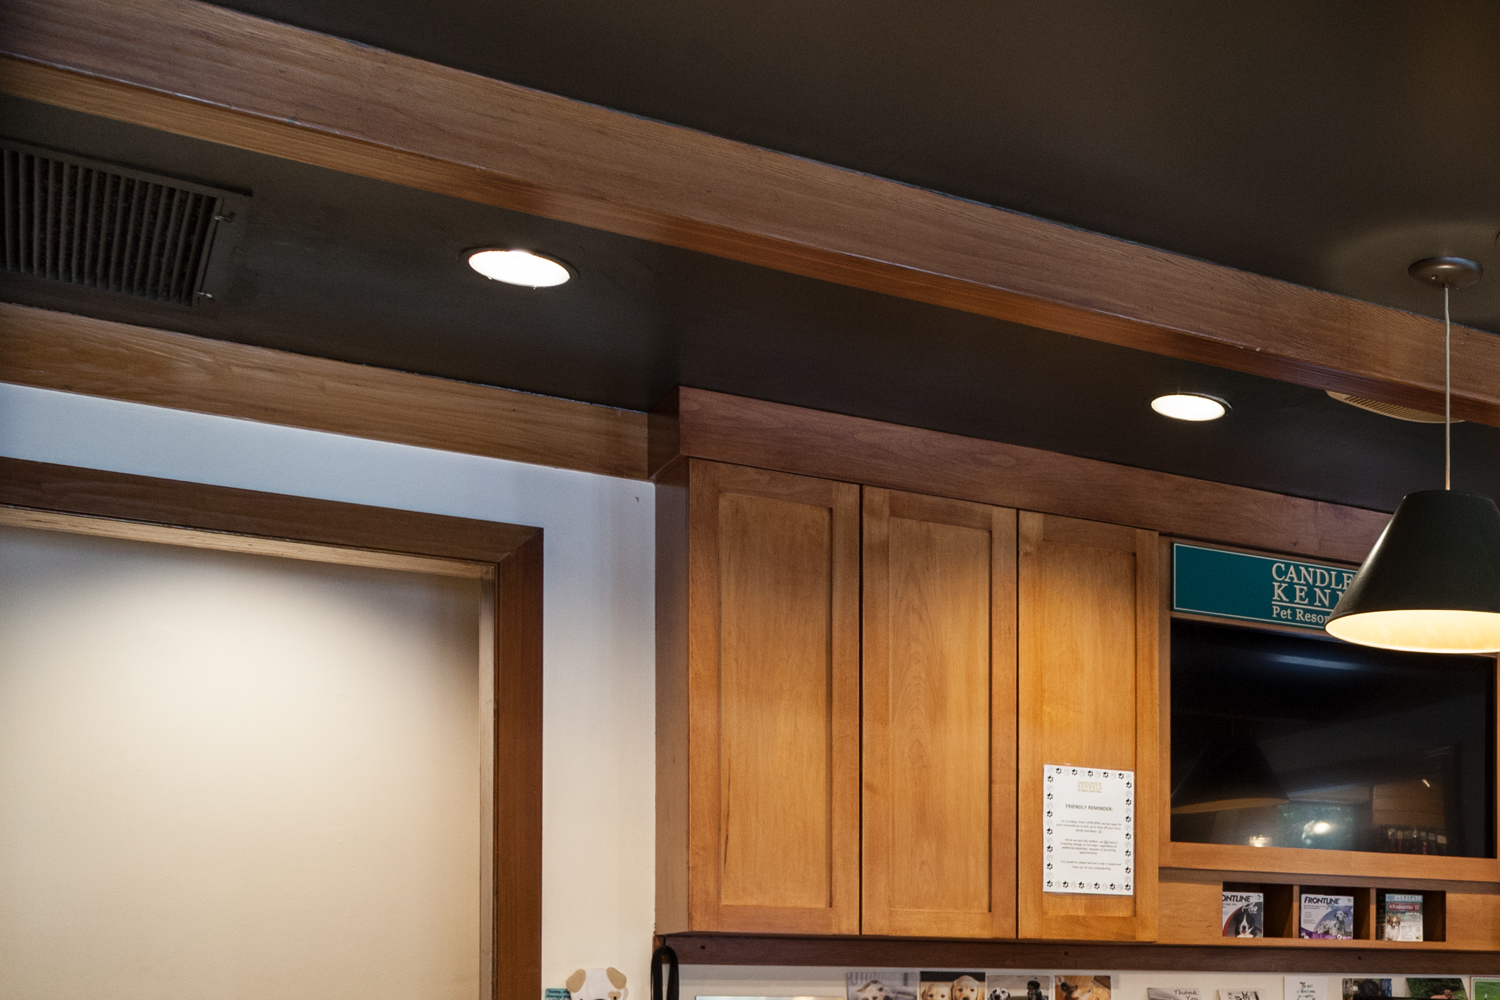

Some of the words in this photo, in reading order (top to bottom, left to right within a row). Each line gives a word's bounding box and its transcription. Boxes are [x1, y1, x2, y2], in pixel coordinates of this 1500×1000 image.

[1272, 563, 1353, 589] CANDLE
[1272, 606, 1292, 619] Pet
[1296, 609, 1330, 623] Resor
[1222, 894, 1251, 902] ONTLINE
[1304, 896, 1340, 904] FRONTLINE
